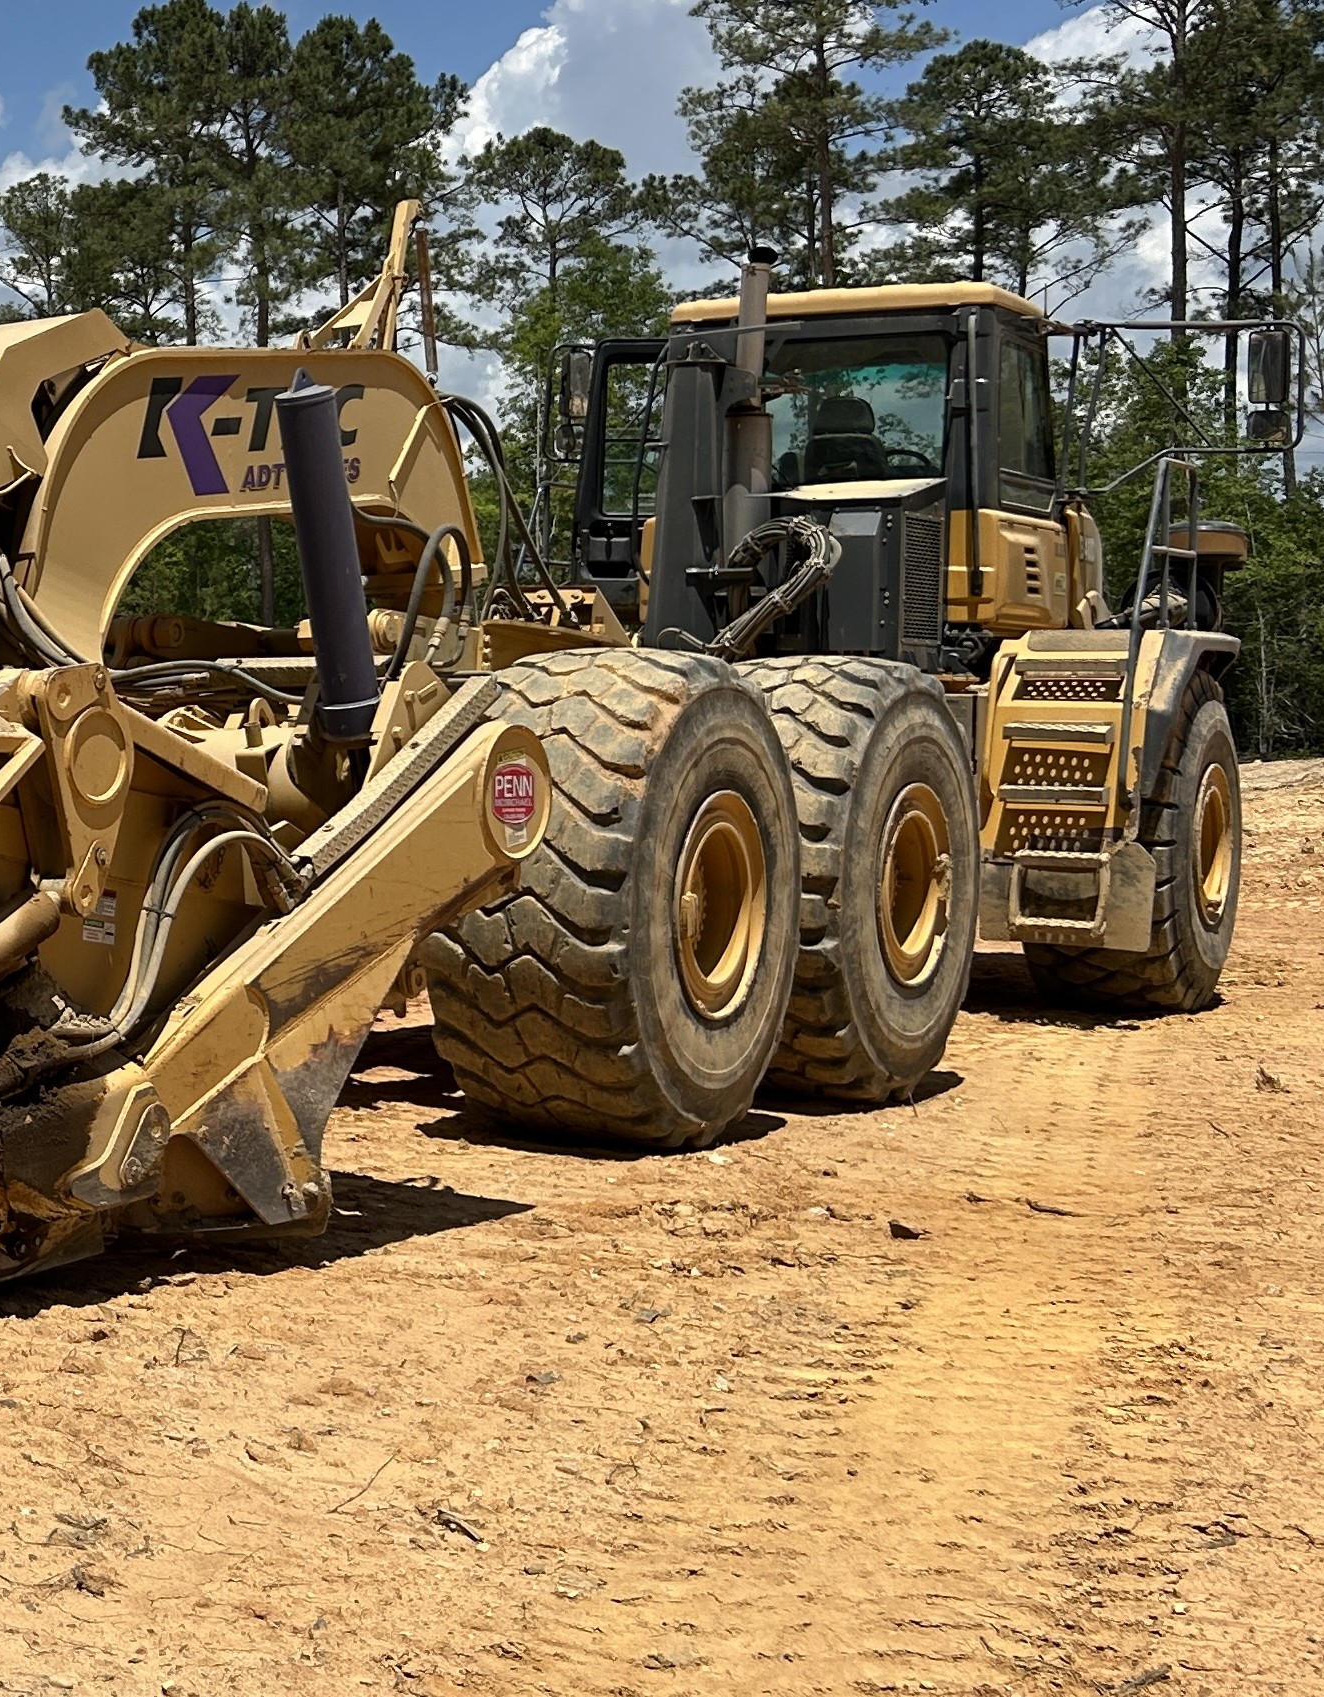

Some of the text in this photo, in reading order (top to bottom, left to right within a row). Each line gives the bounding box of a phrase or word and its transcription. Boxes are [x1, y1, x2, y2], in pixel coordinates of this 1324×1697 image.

[137, 374, 365, 496] K-TC
[239, 463, 287, 492] ADT
[495, 774, 532, 797] PENN
